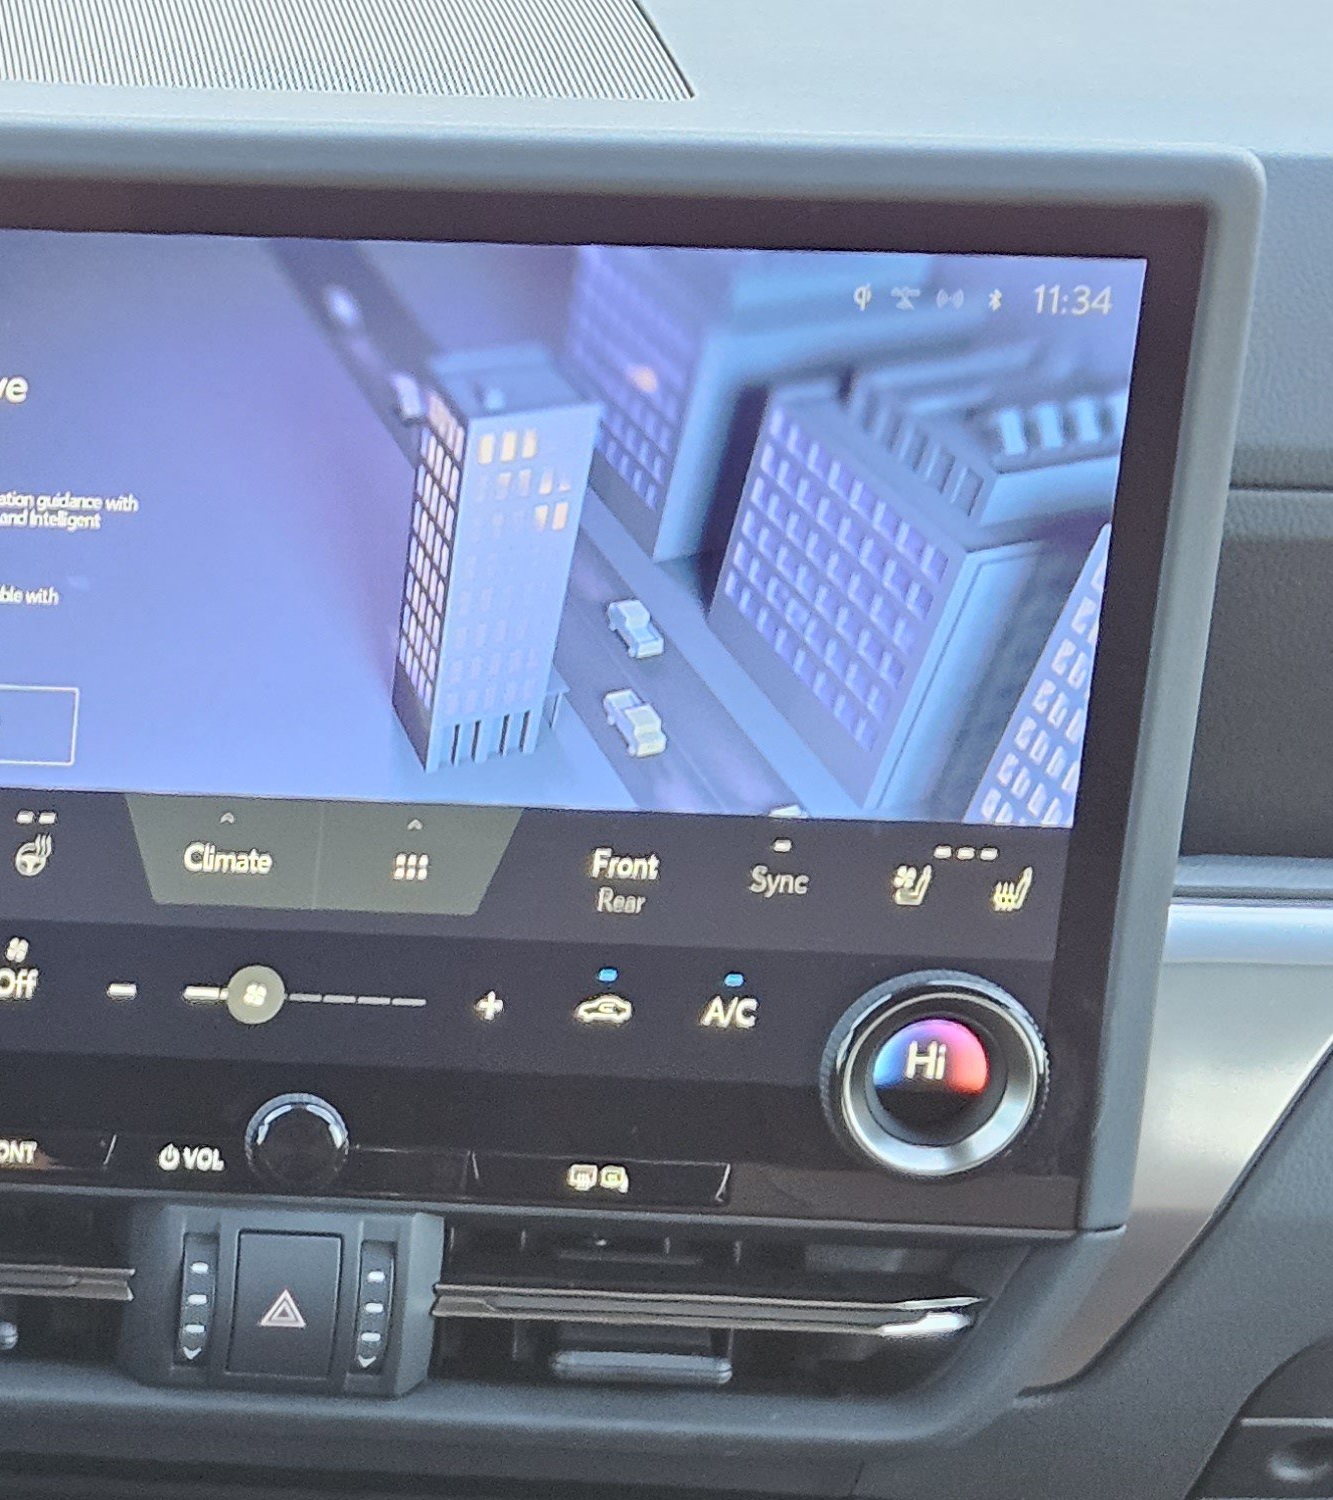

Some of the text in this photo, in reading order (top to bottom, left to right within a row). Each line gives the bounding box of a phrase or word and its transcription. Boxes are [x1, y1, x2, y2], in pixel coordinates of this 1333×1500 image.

[1035, 284, 1112, 316] 11:34
[36, 492, 102, 512] guidance
[105, 494, 139, 513] with
[0, 508, 27, 527] and
[29, 509, 102, 533] Intelligent
[25, 587, 60, 606] with
[183, 841, 274, 876] Climate
[590, 846, 661, 882] Front
[750, 864, 809, 898] Sync
[596, 886, 647, 915] Rear
[699, 994, 760, 1030] A/C
[903, 1040, 946, 1082] Hi
[182, 1145, 226, 1173] VOL
